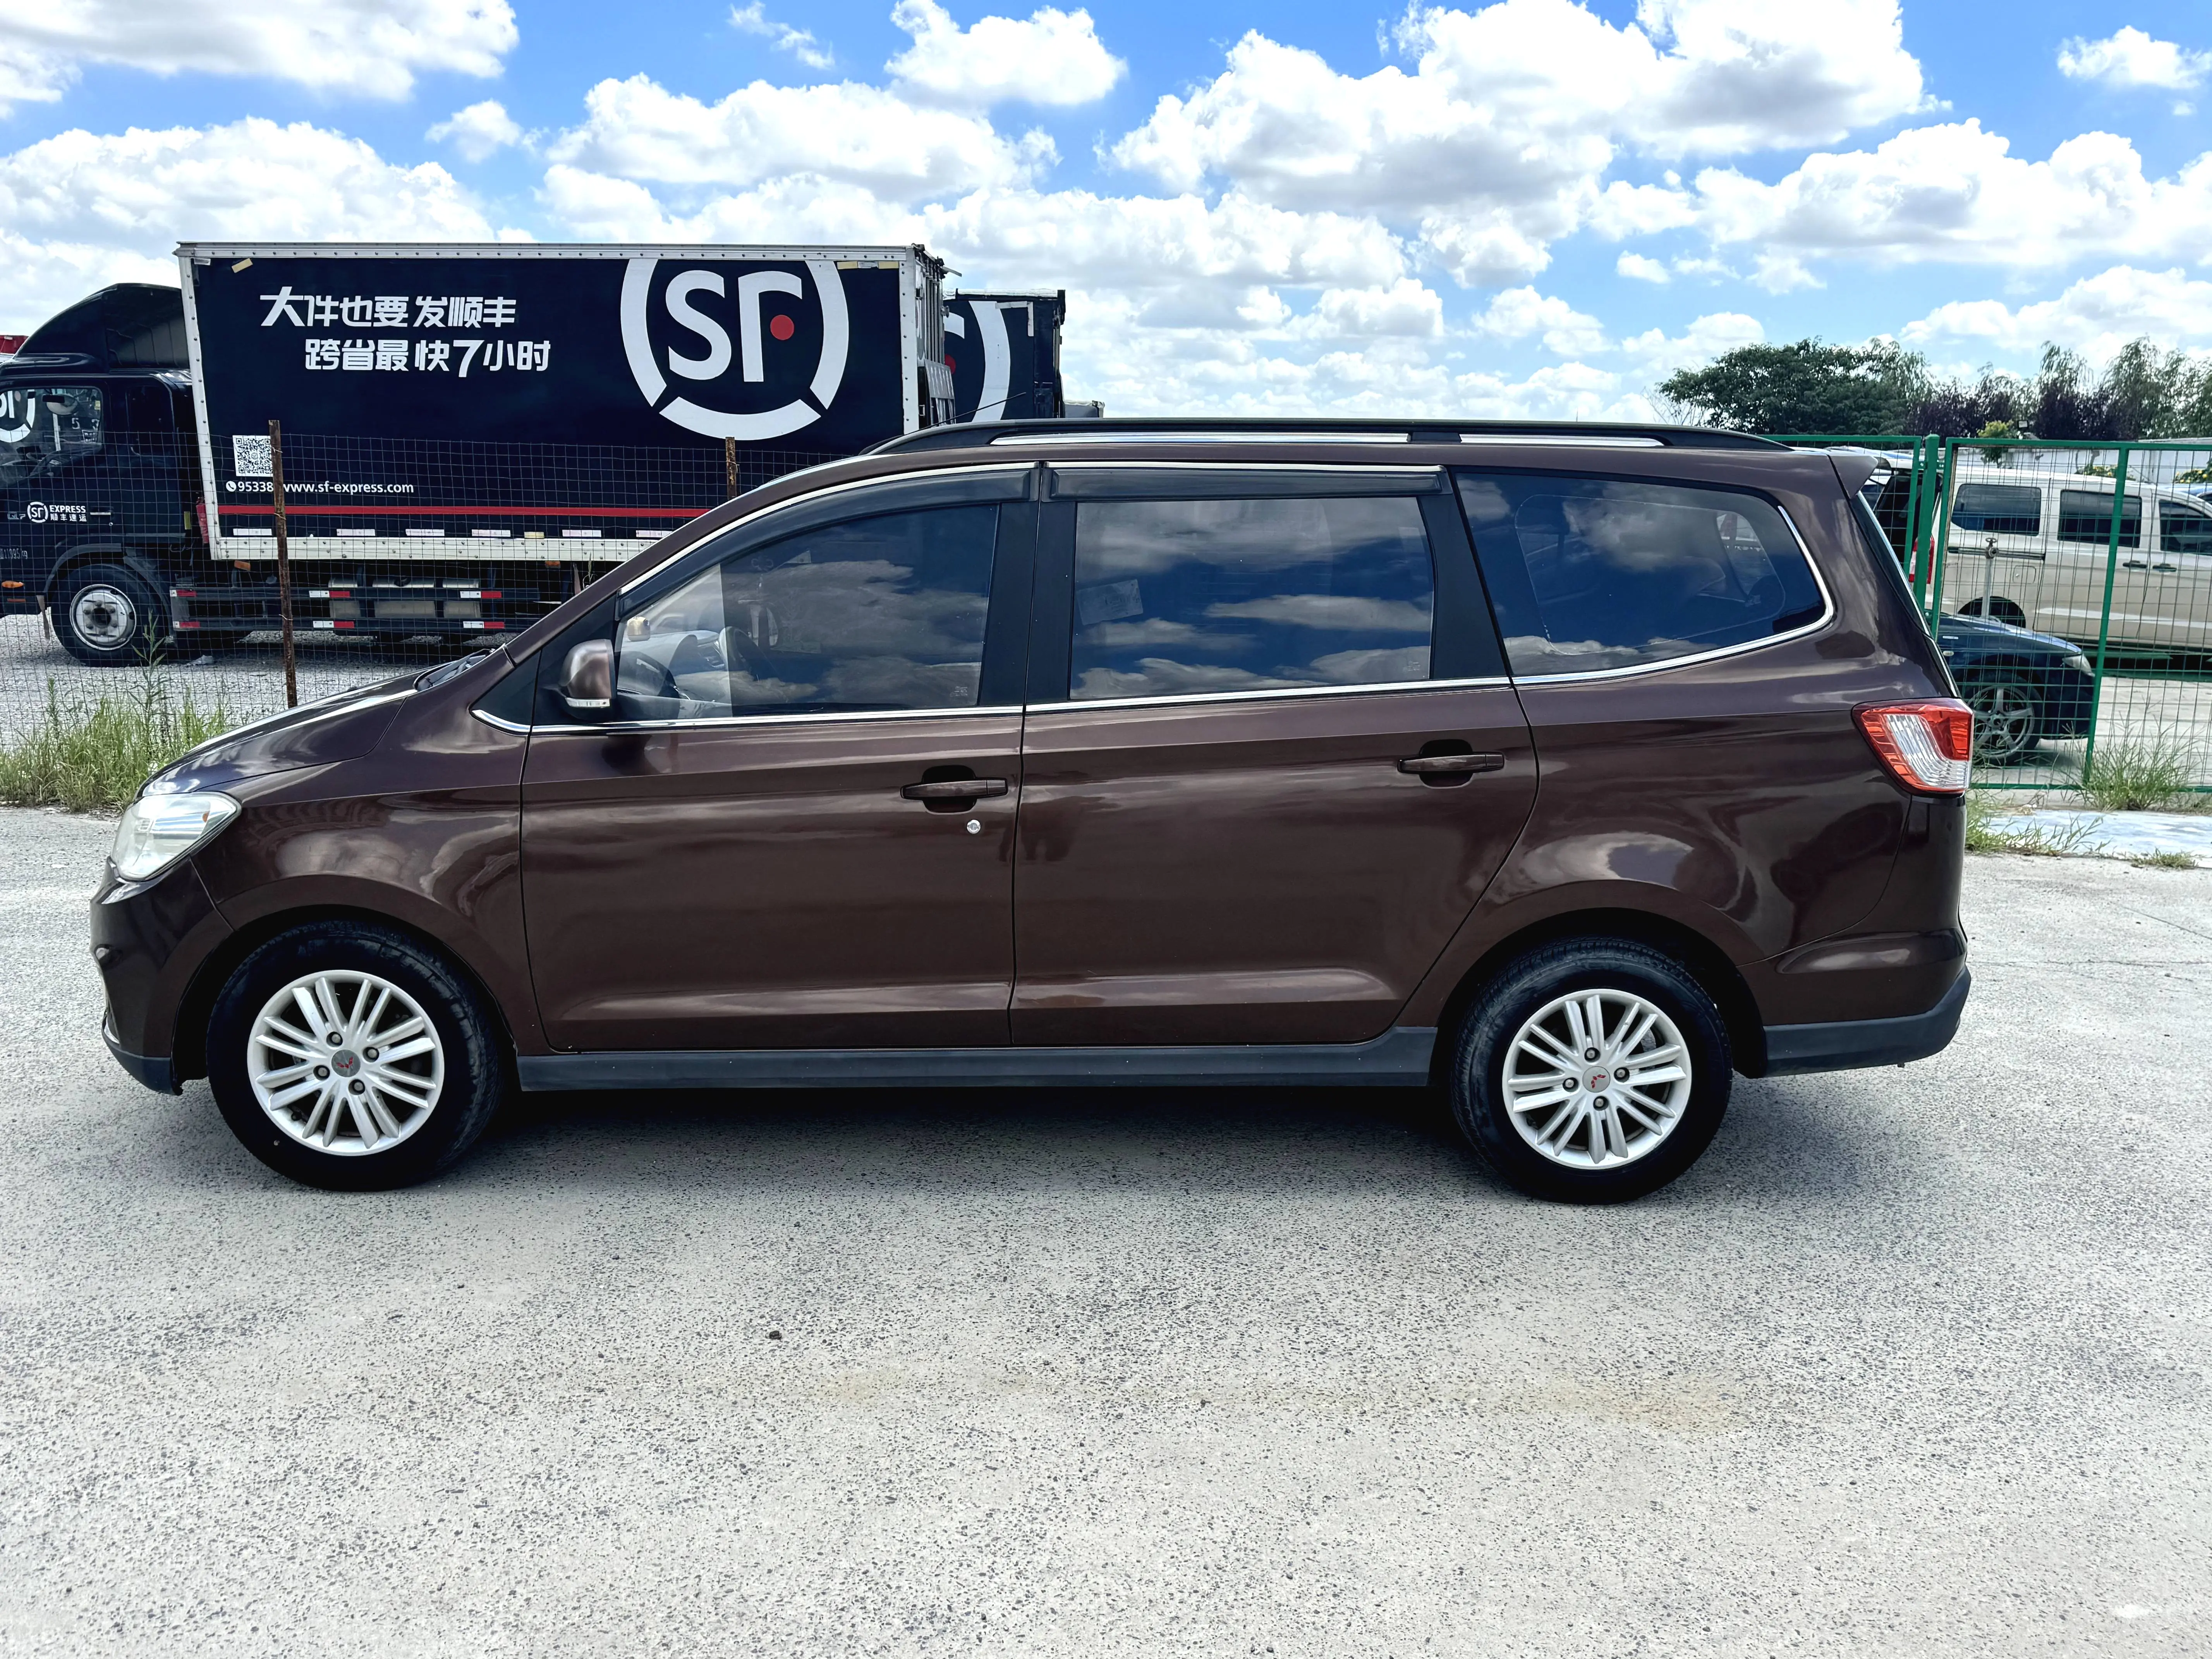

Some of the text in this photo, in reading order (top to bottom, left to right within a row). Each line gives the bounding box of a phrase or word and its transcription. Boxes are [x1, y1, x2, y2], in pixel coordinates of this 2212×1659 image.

[260, 286, 516, 328] 大件也要发顺丰
[306, 339, 551, 377] 跨省最快7小时
[238, 481, 274, 492] 95338
[49, 505, 86, 513] EXPRESS
[50, 513, 87, 522] 顺丰速运
